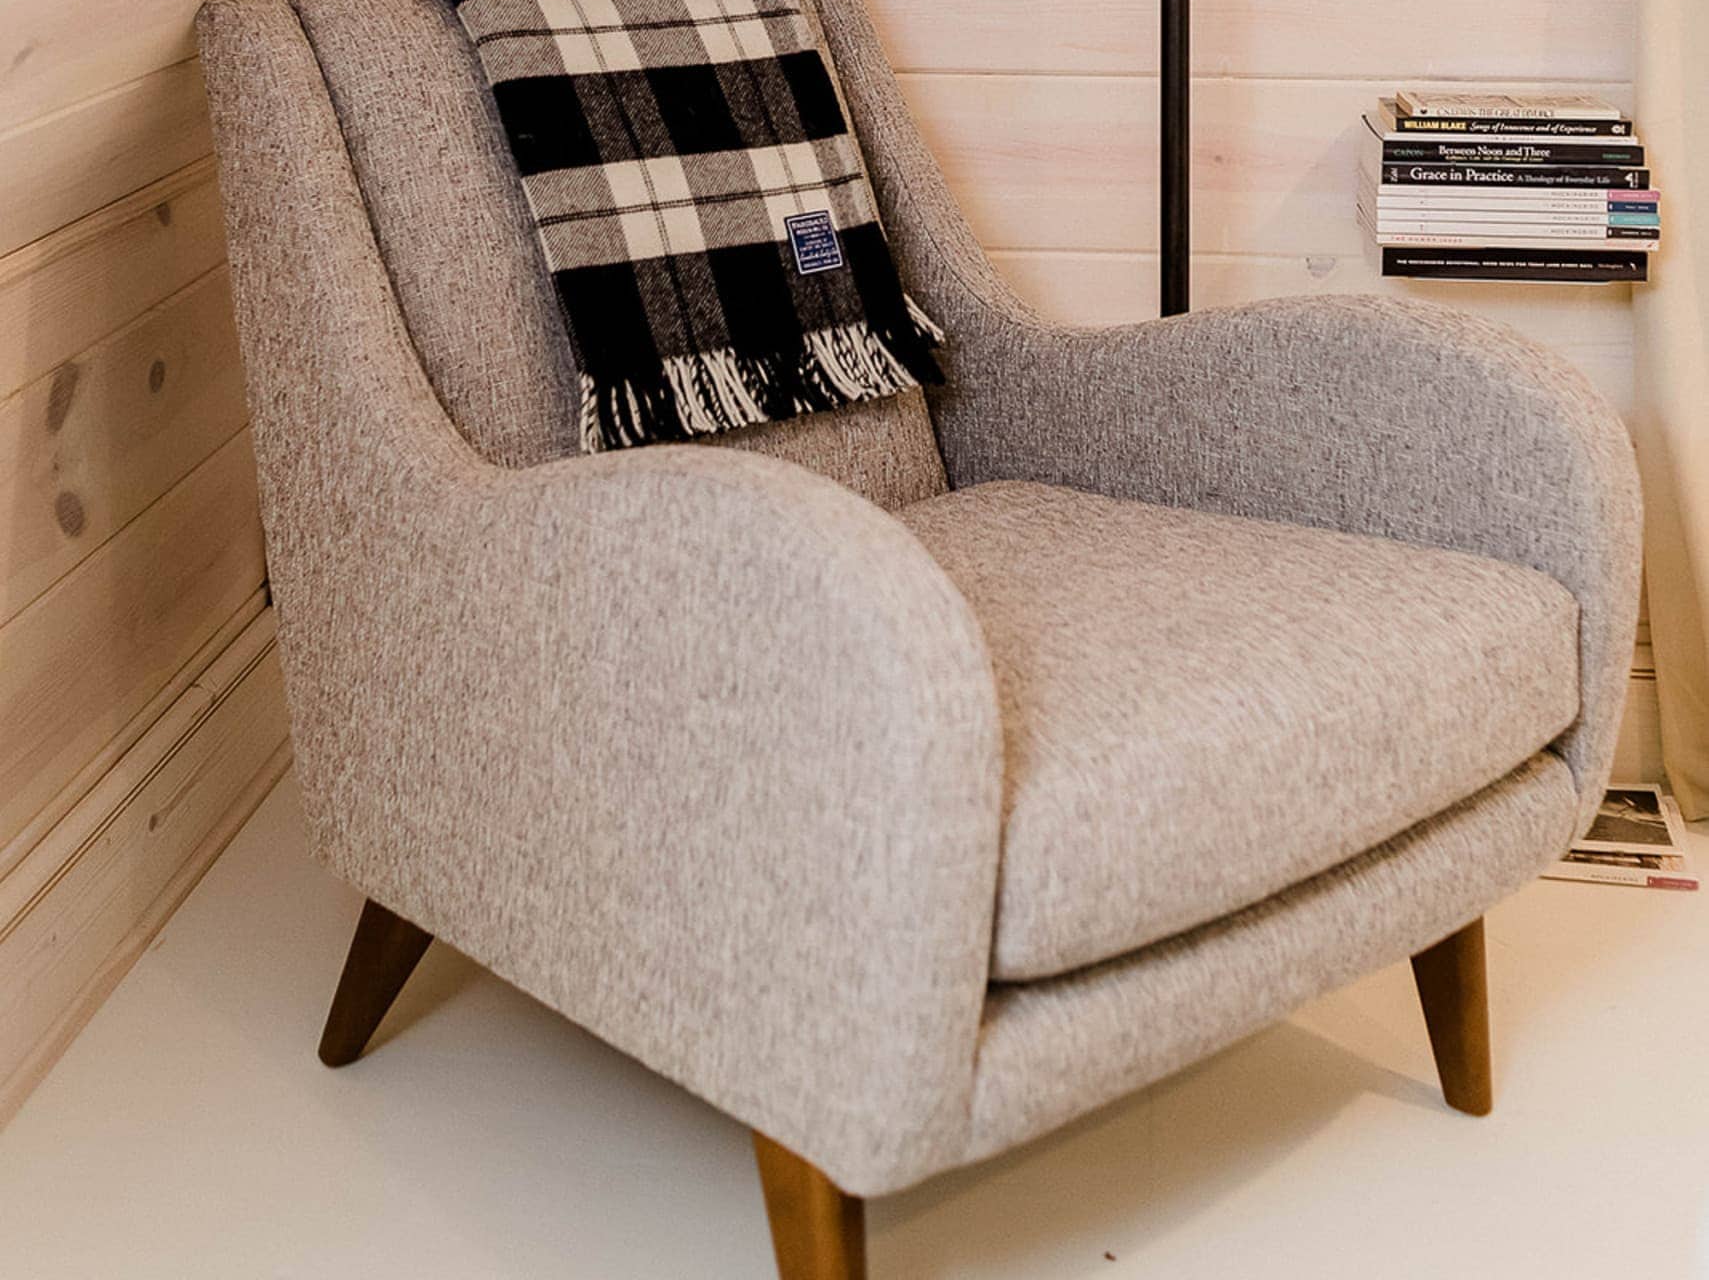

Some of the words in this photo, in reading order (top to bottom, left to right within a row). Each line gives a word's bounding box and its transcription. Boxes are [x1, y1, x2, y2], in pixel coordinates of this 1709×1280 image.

[1403, 120, 1440, 129] WILLIAM
[1440, 121, 1467, 130] BLAKE
[1438, 145, 1476, 156] Between
[1478, 145, 1503, 156] Noon
[1505, 147, 1522, 157] and
[1522, 146, 1551, 158] Three
[1410, 167, 1448, 181] Grace
[1450, 168, 1462, 181] in
[1466, 168, 1514, 182] Practice
[1525, 174, 1554, 185] Theology
[1556, 175, 1563, 183] of
